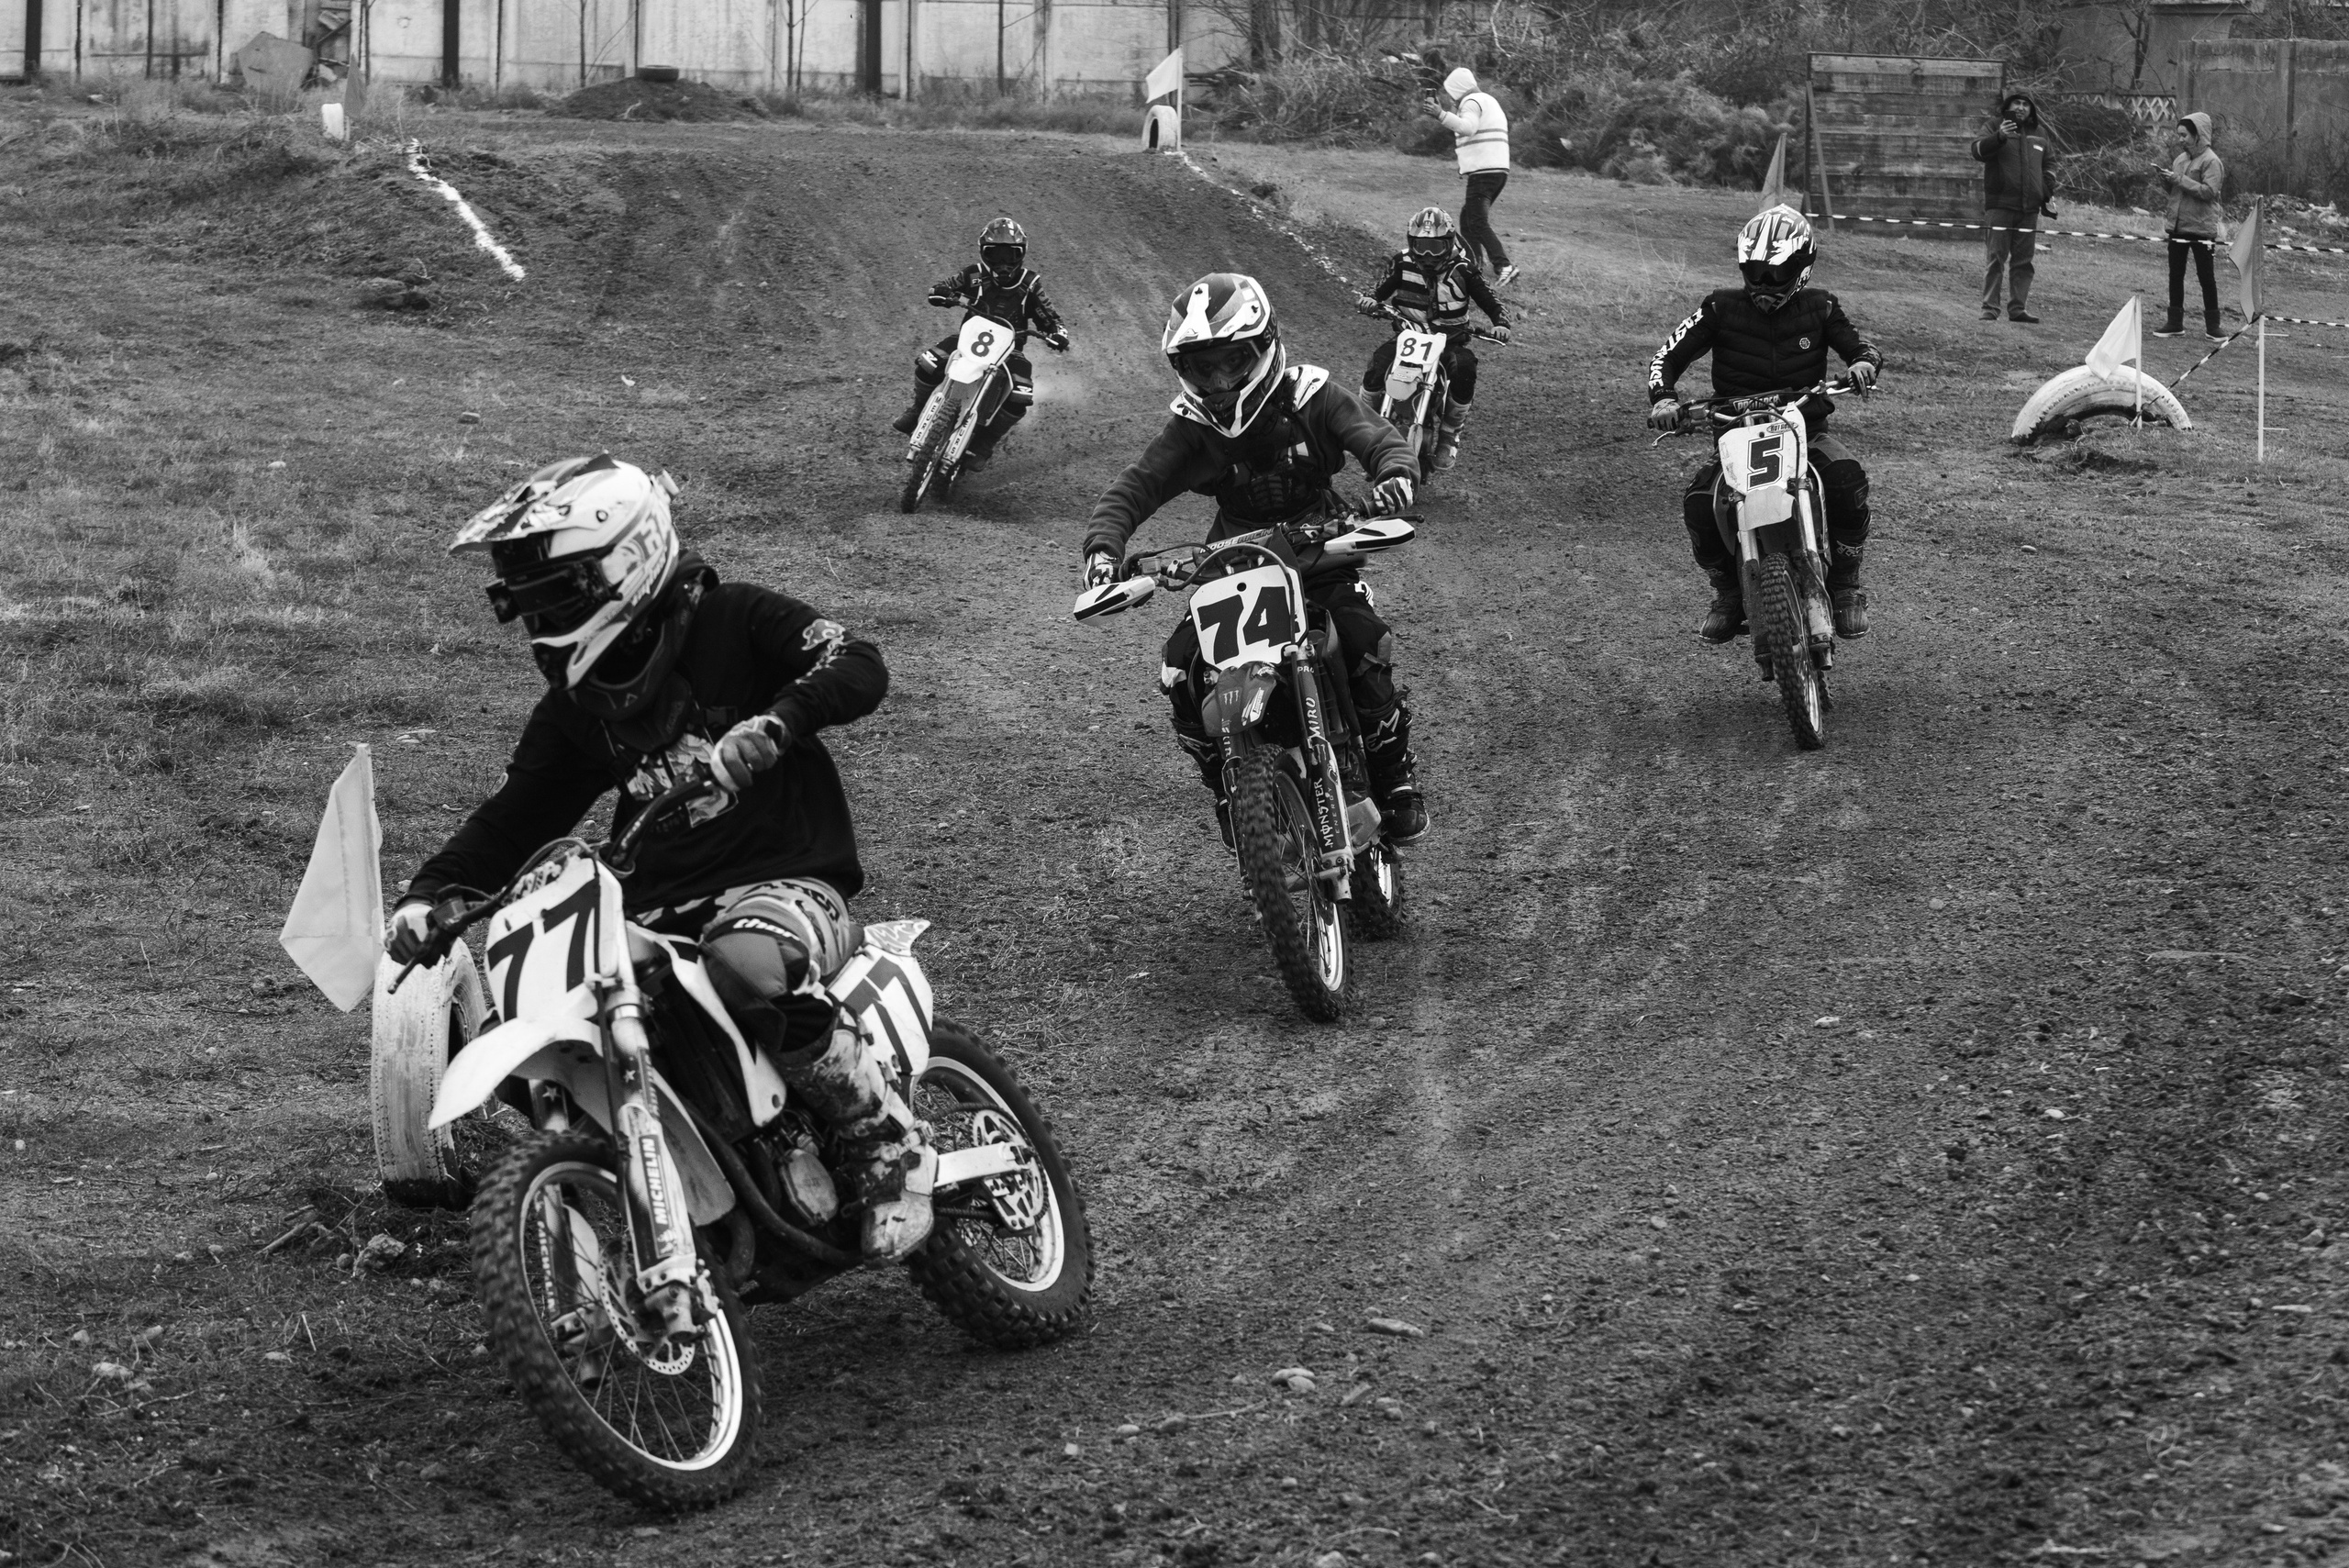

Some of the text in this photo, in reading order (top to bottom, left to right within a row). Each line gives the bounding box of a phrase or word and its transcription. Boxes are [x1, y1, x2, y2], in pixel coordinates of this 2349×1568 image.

[971, 331, 995, 357] 8
[1400, 337, 1433, 361] 81
[1747, 433, 1784, 492] 5
[1197, 586, 1300, 665] 74
[1313, 777, 1334, 848] MONSTER
[487, 878, 599, 1023] 77
[842, 955, 932, 1073] 77
[641, 1138, 668, 1225] MICHELIN
